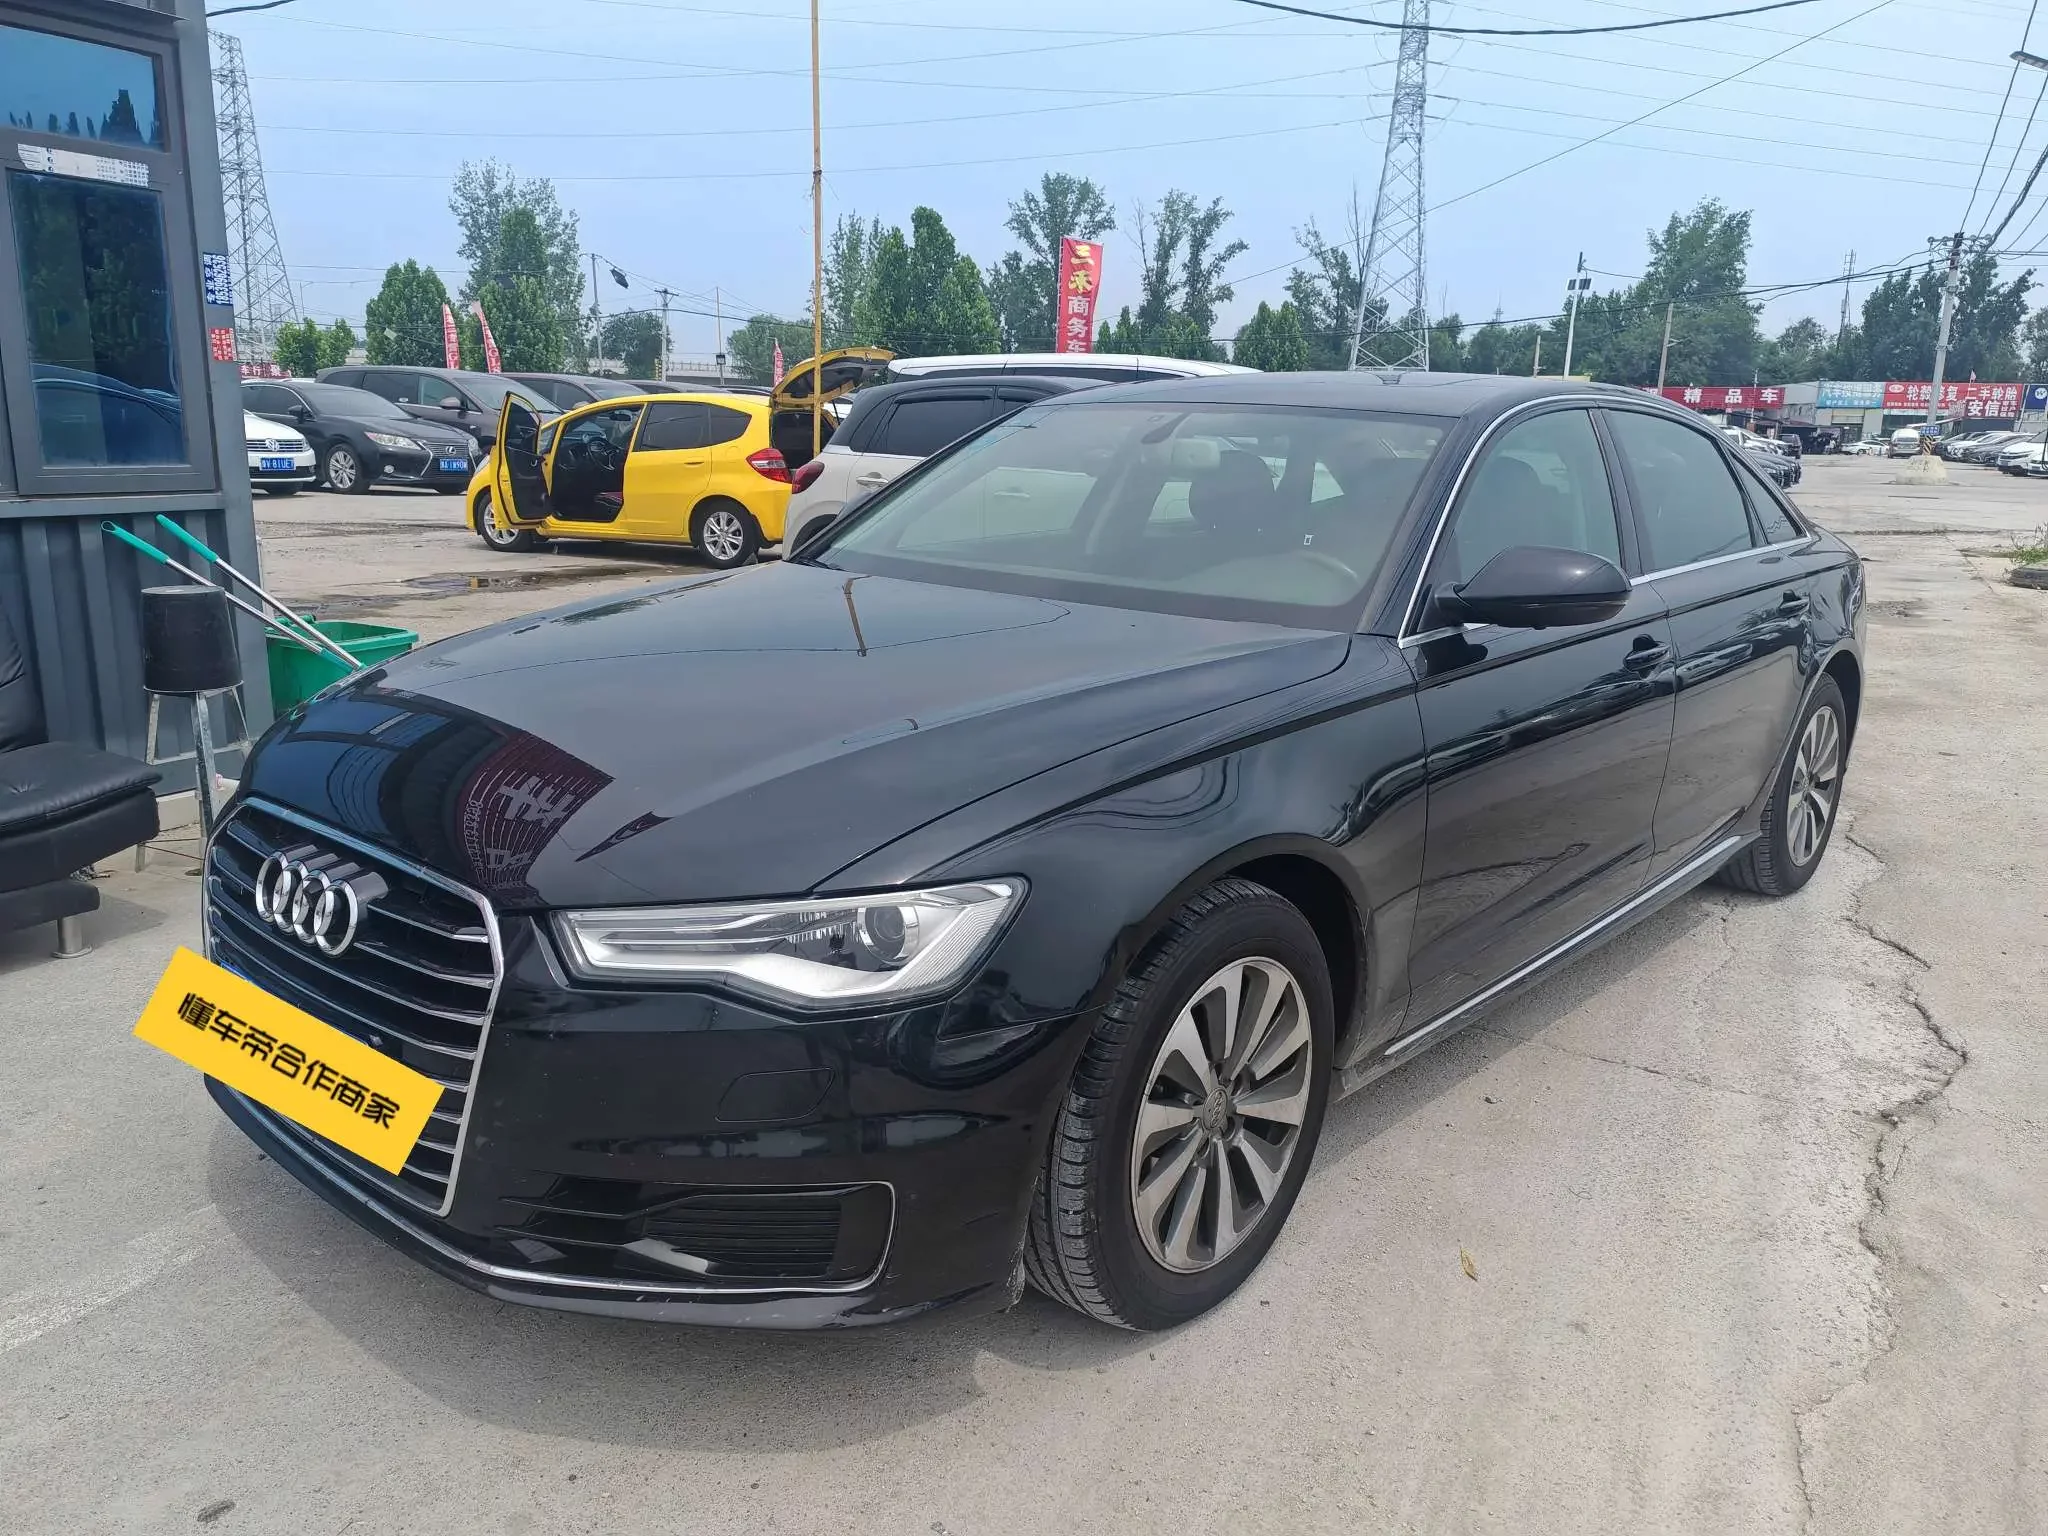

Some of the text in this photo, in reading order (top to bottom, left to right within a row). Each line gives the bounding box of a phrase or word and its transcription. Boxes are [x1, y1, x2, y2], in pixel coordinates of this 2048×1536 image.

[1965, 386, 2018, 401] 二手轮胎
[1968, 400, 2001, 417] 安信
